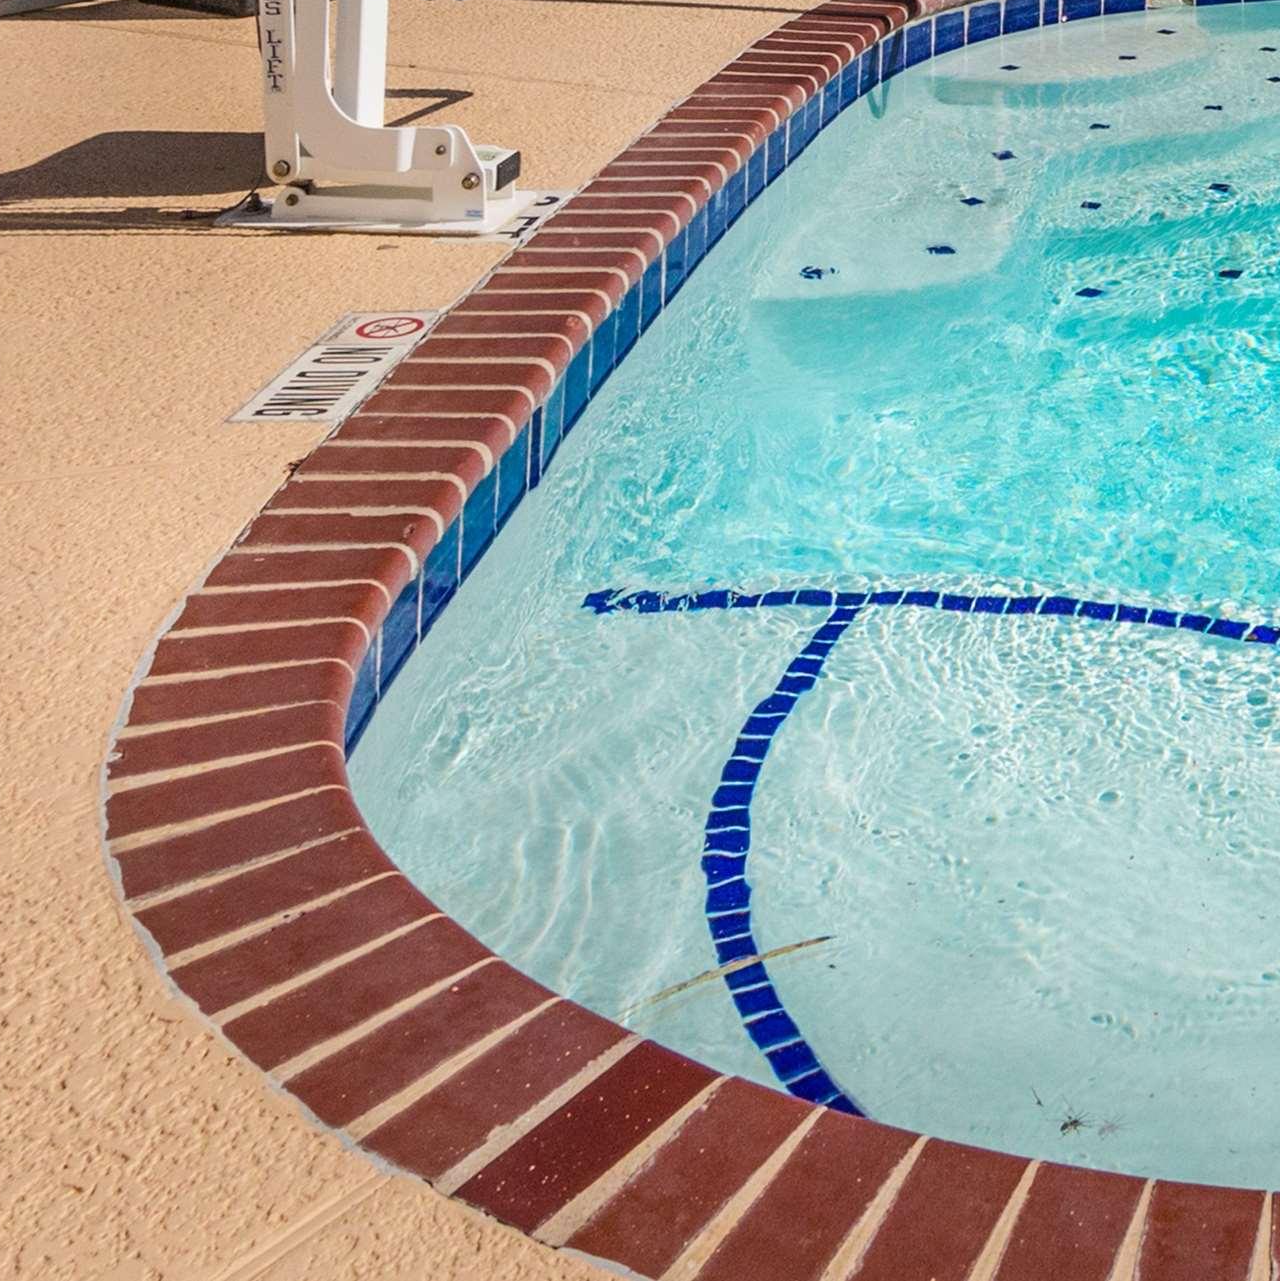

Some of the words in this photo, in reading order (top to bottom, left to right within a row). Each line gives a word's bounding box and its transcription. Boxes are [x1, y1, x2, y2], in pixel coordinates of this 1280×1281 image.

[266, 29, 283, 89] LIFT
[311, 347, 394, 365] NO
[251, 370, 370, 417] DIVING
